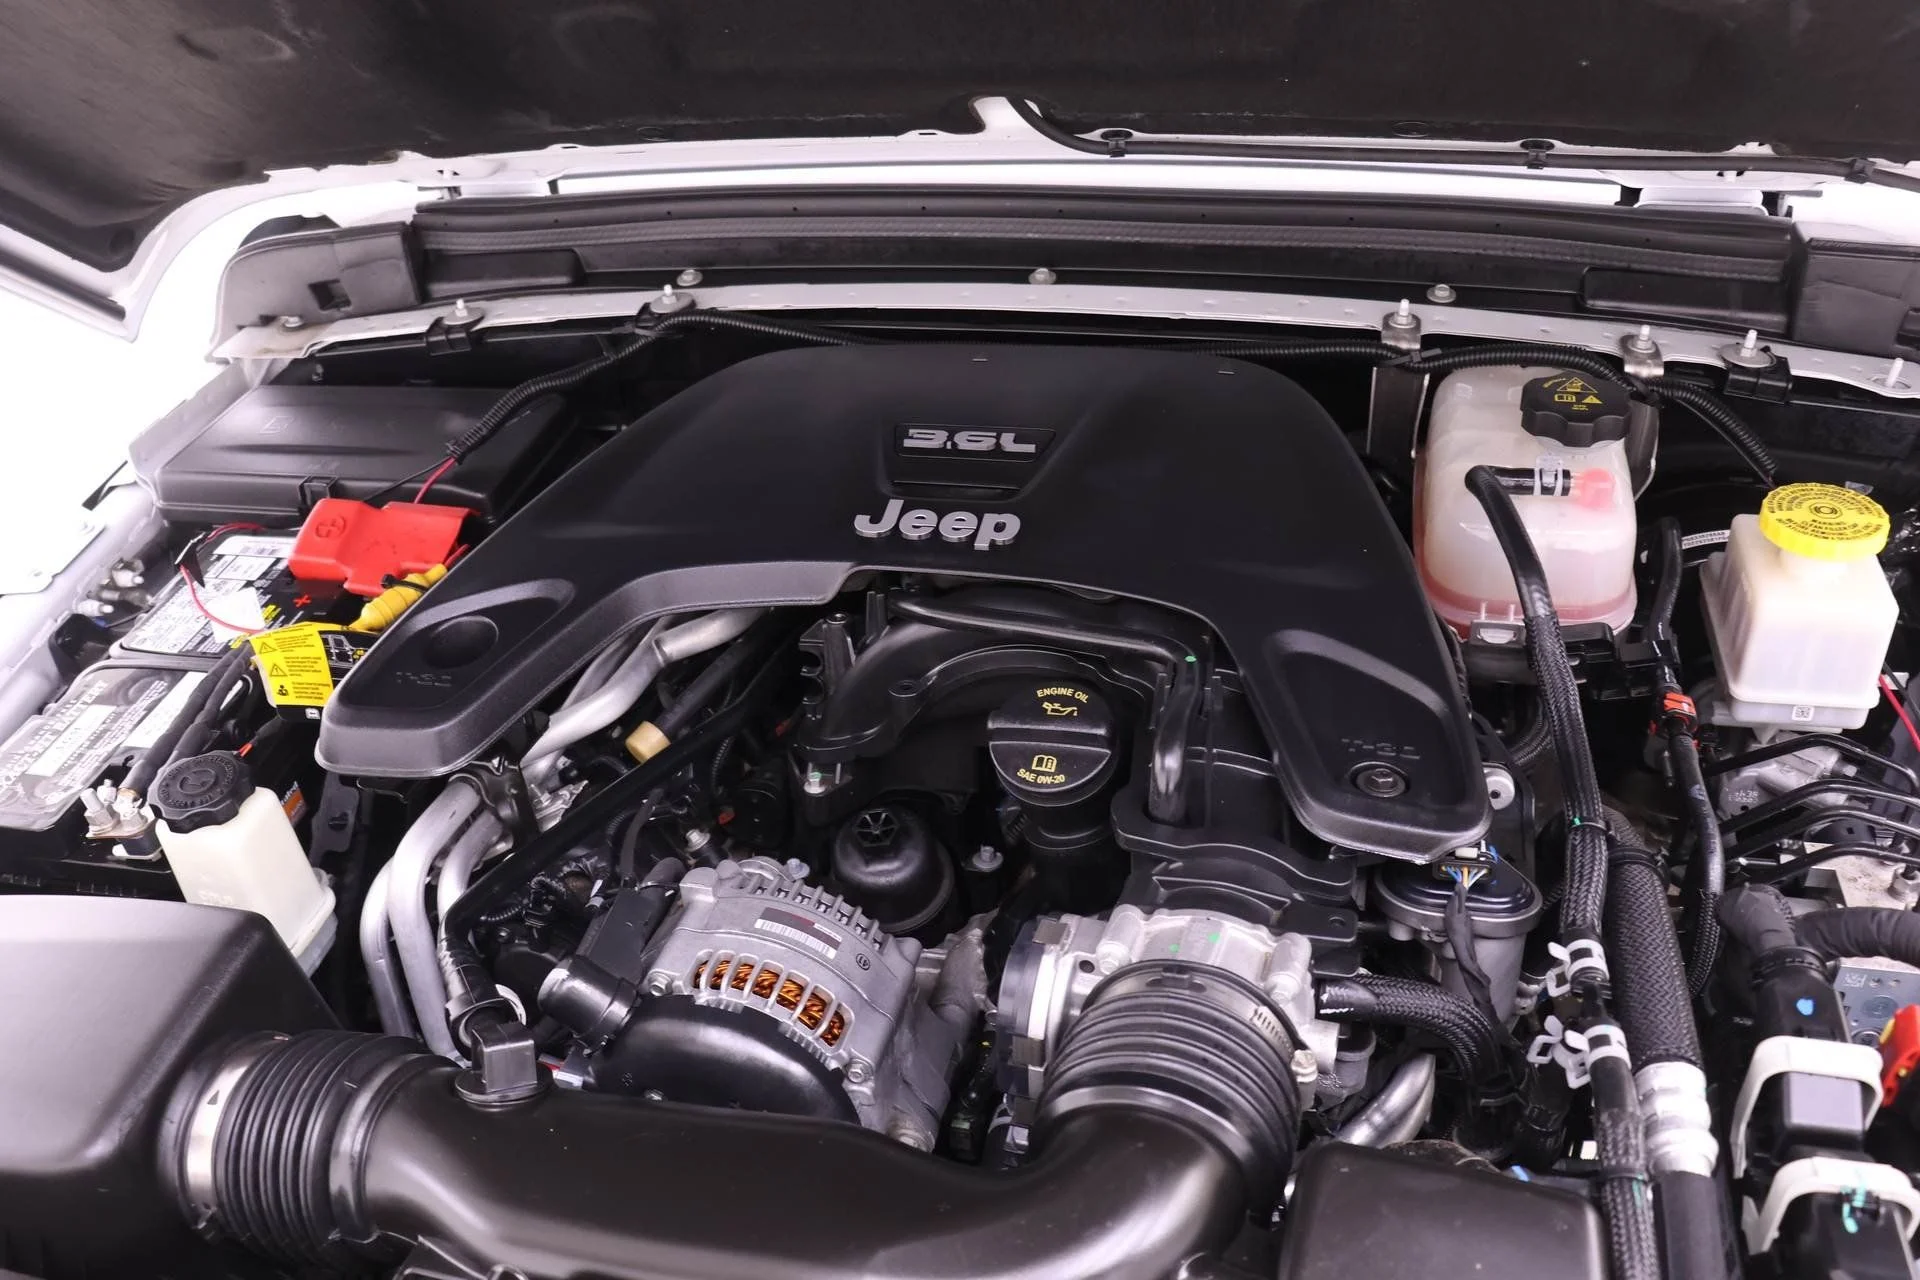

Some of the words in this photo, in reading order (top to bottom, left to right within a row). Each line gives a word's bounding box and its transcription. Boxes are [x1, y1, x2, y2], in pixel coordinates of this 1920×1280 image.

[903, 428, 1036, 453] 3.6L
[854, 499, 1021, 551] Jeep
[1036, 687, 1074, 698] ENGINE
[1074, 691, 1089, 703] OIL
[1017, 768, 1038, 783] SAE
[1037, 774, 1065, 784] 0W-20
